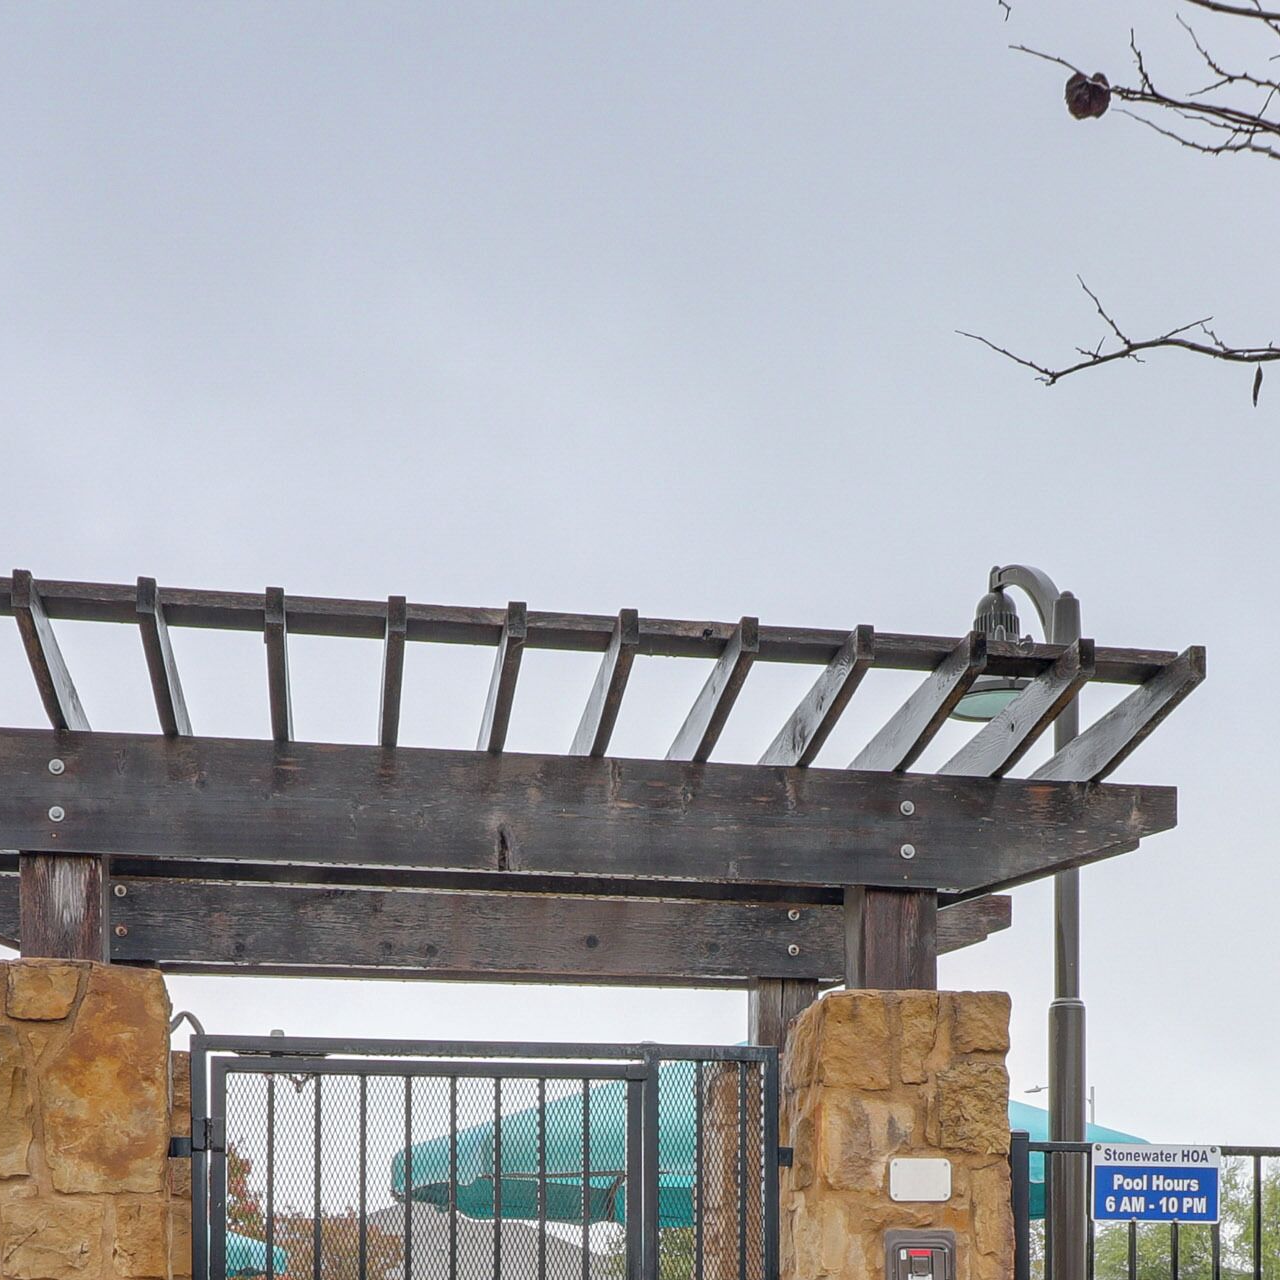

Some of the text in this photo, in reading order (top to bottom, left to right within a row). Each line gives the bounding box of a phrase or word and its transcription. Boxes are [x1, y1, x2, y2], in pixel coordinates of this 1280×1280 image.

[1104, 1148, 1208, 1163] Stonewater HOA
[1113, 1174, 1199, 1191] Pool Hours
[1105, 1196, 1116, 1212] 6
[1120, 1196, 1145, 1213] AM
[1159, 1196, 1178, 1213] 10
[1182, 1197, 1207, 1214] PM
